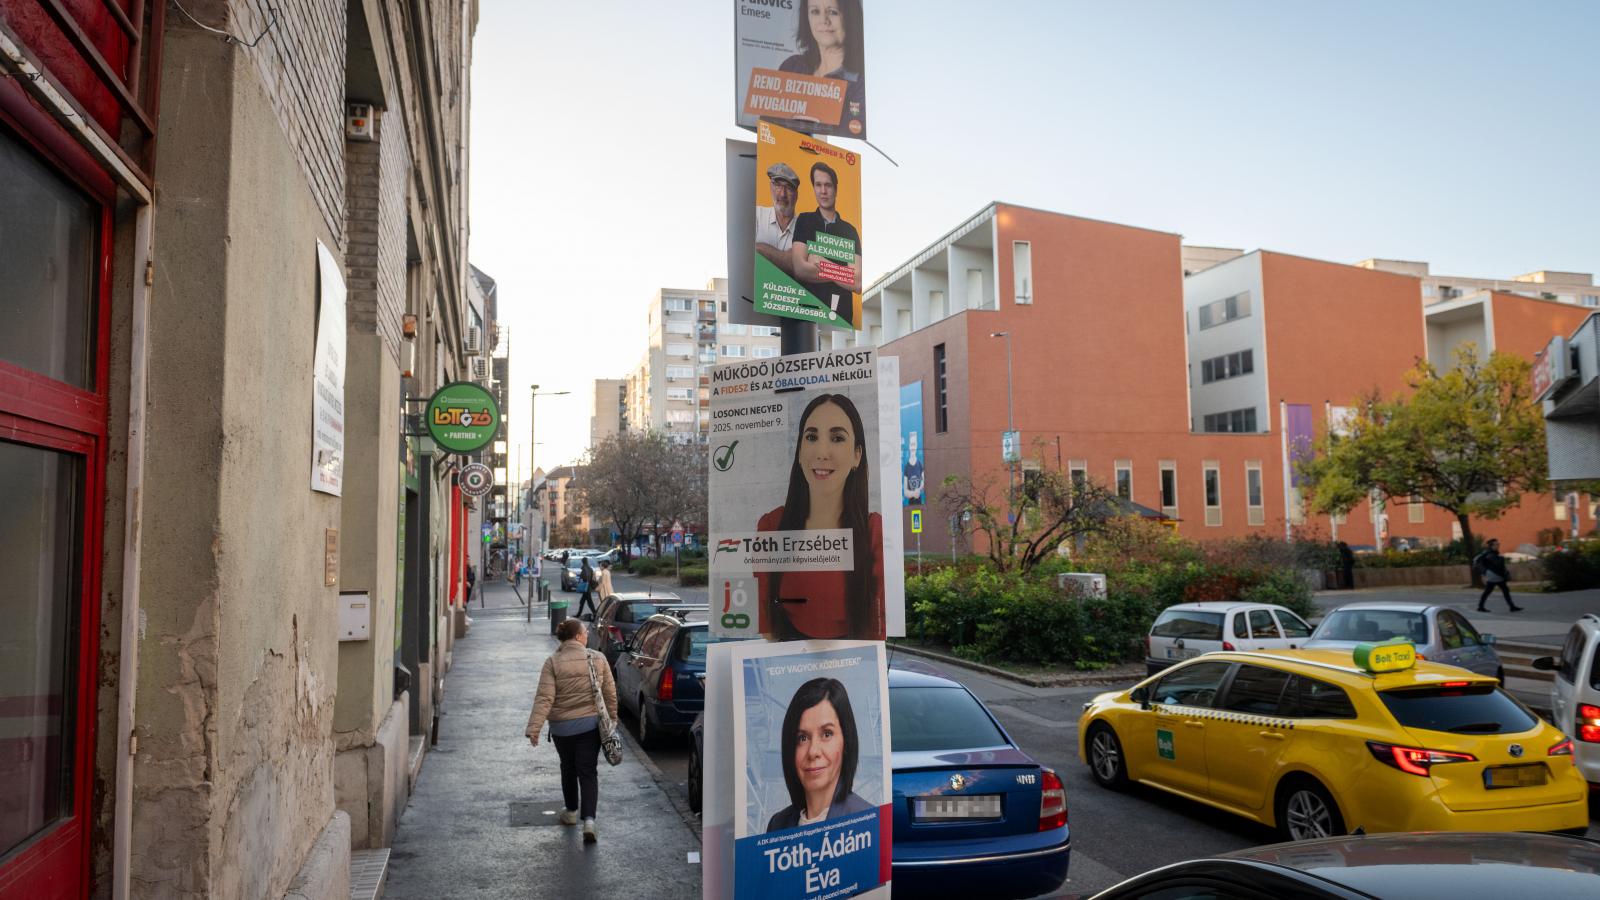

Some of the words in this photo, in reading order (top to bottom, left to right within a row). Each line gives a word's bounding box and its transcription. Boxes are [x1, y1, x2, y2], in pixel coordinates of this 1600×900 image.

[741, 5, 771, 20] Emese
[753, 75, 782, 94] REND,
[785, 79, 842, 102] BIZTONSÁG,
[750, 94, 807, 115] NYUGALOM
[801, 140, 838, 157] NOVEMBER
[816, 235, 854, 251] HORVÁTH
[808, 244, 854, 260] ALEXANDER
[763, 282, 797, 294] KÜLDJÜK
[798, 289, 807, 297] EL
[770, 293, 800, 304] FIDESZT
[771, 351, 872, 376] JÓZSEFVÁROST
[713, 387, 719, 395] A
[720, 384, 748, 395] FIDESZ
[750, 382, 760, 391] ÉS
[762, 381, 773, 390] AZ
[775, 374, 830, 388] ÓBALOLDAL
[832, 369, 872, 382] NÉLKÜL!
[713, 407, 748, 419] LOSONCI
[750, 404, 783, 415] NEGYED
[713, 422, 733, 433] 2025.
[735, 418, 773, 431] november
[775, 417, 784, 427] 9.
[449, 431, 477, 439] PARTNER
[743, 537, 778, 553] Tóth
[783, 535, 848, 551] Erzsébet
[1375, 653, 1392, 664] Bolt
[1392, 650, 1410, 661] Taxi
[788, 663, 818, 674] VAGYOK
[764, 830, 872, 874] Tóth-Ádám
[805, 863, 840, 894] Éva
